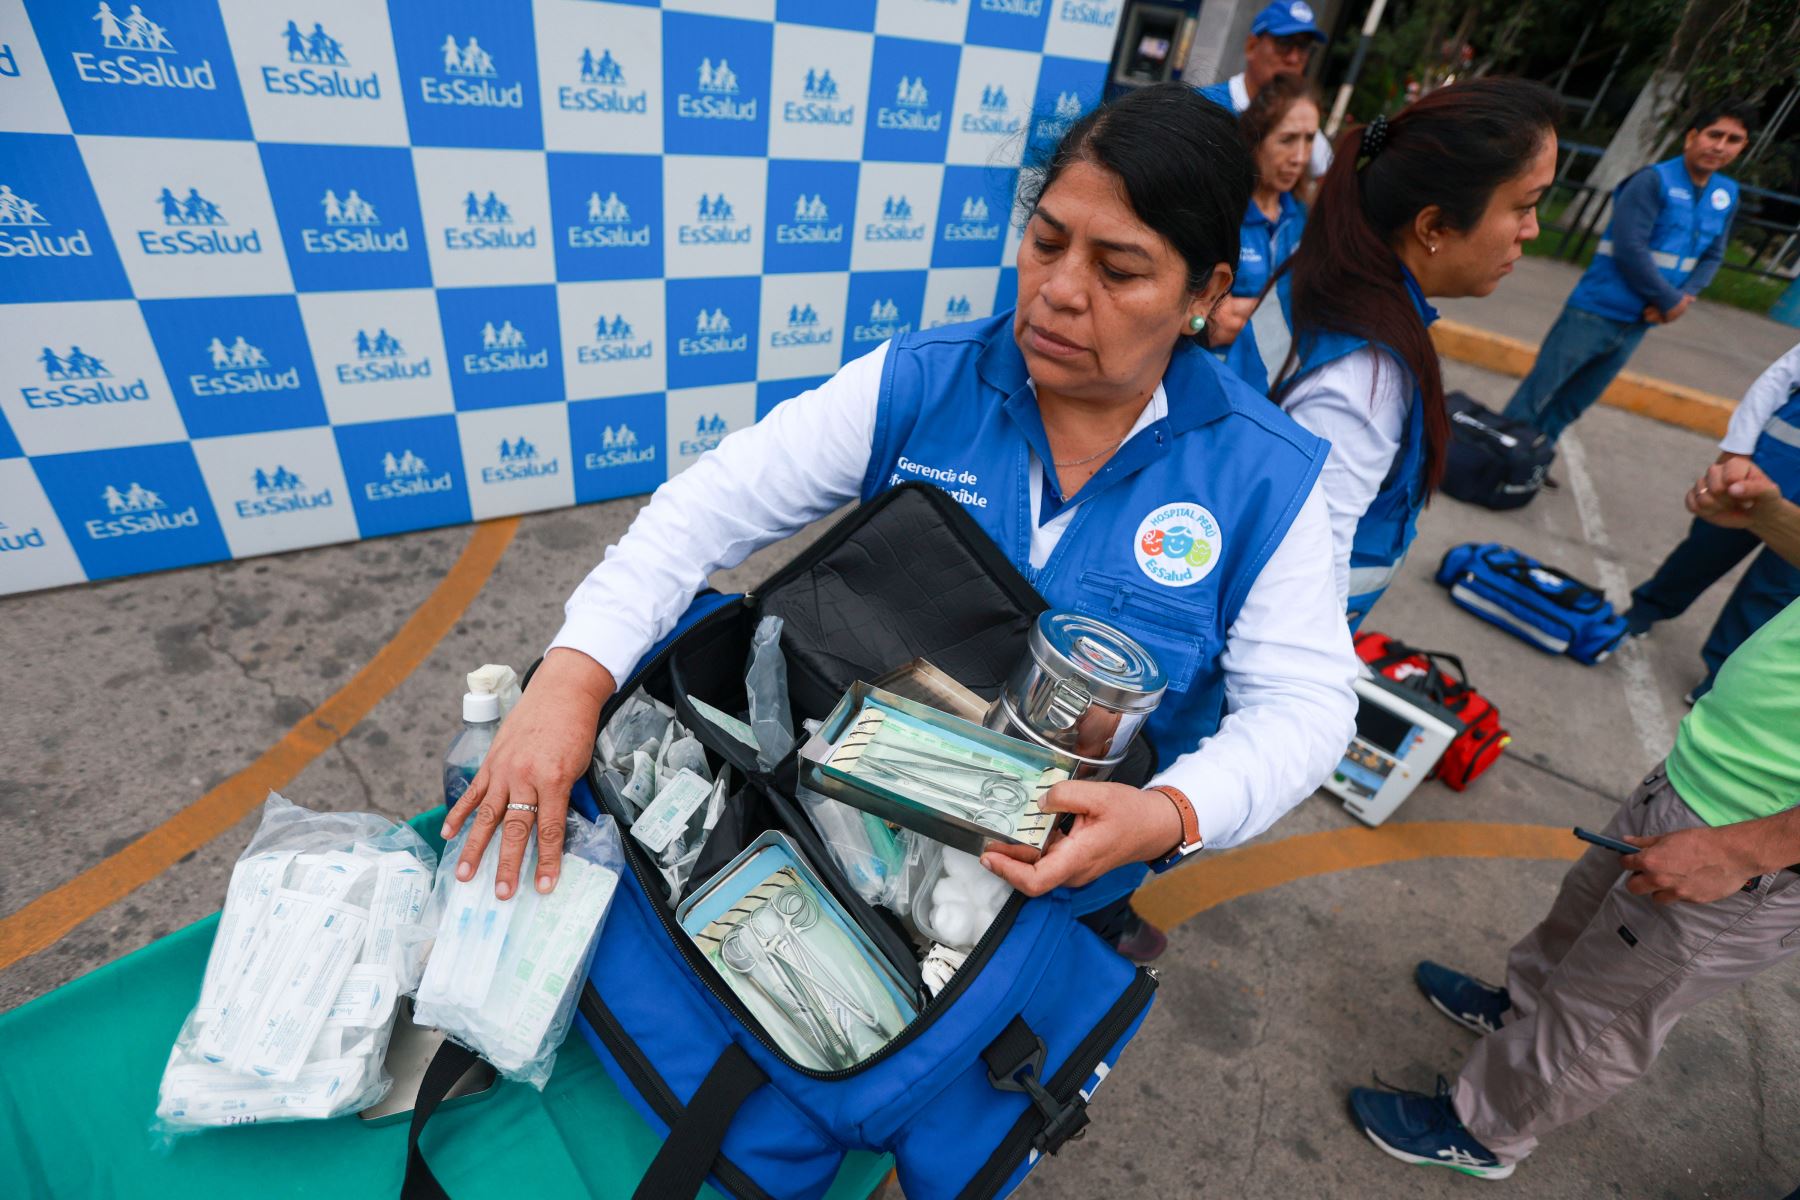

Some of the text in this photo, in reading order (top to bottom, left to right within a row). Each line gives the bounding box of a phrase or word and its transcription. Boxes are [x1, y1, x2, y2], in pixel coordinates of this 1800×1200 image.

[72, 51, 216, 90] EsSalud
[261, 66, 380, 99] EsSalud
[420, 77, 522, 109] EsSalud
[558, 86, 648, 114] EsSalud
[677, 94, 757, 121] EsSalud
[783, 102, 853, 126] EsSalud
[877, 107, 942, 132] EsSalud
[137, 229, 262, 256] EsSalud
[302, 227, 409, 253] EsSalud
[444, 226, 536, 250] EsSalud
[568, 225, 650, 248] EsSalud
[678, 225, 752, 245] EsSalud
[776, 224, 843, 244] EsSalud
[864, 223, 925, 241] EsSalud
[944, 222, 999, 241] EsSalud
[678, 335, 748, 356] EsSalud
[769, 327, 832, 348] EsSalud
[463, 348, 549, 374] EsSalud
[576, 341, 653, 364] EsSalud
[190, 367, 300, 396] EsSalud
[336, 357, 431, 384] EsSalud
[20, 379, 149, 409] EsSalud
[584, 446, 655, 470] EsSalud
[897, 456, 957, 482] Gerencia
[958, 470, 978, 485] de
[482, 459, 559, 484] EsSalud
[365, 472, 453, 501] EsSalud
[234, 489, 333, 518] EsSalud
[86, 508, 199, 539] EsSalud
[1150, 508, 1195, 526] HOSPITAL
[1145, 558, 1193, 581] EsSalud
